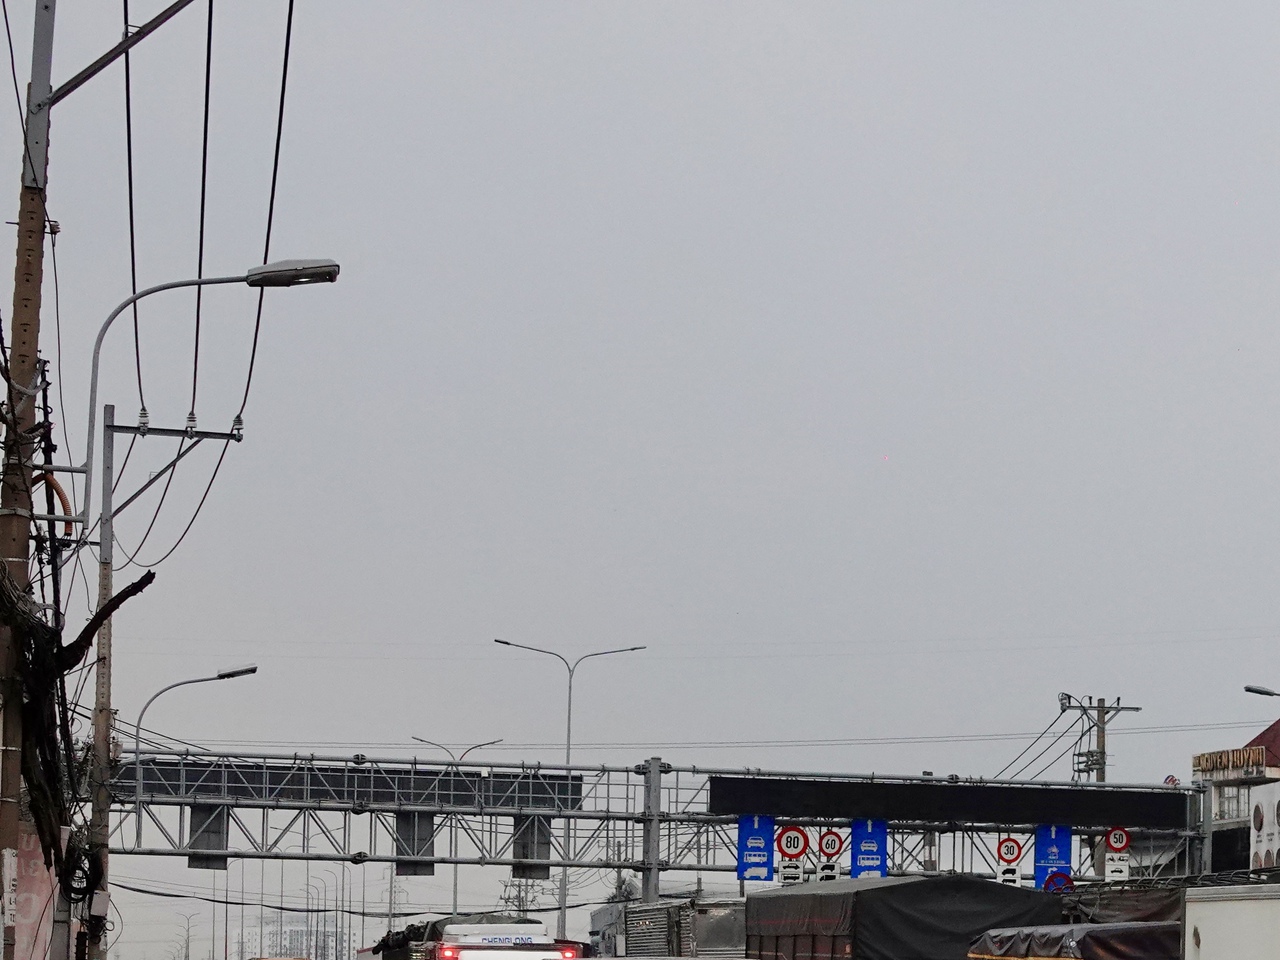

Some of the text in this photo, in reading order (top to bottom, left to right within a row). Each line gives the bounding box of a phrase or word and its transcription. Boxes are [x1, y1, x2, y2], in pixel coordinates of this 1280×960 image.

[785, 835, 800, 849] 80
[825, 838, 836, 850] 60
[1113, 833, 1124, 844] 50
[1003, 844, 1015, 856] 30
